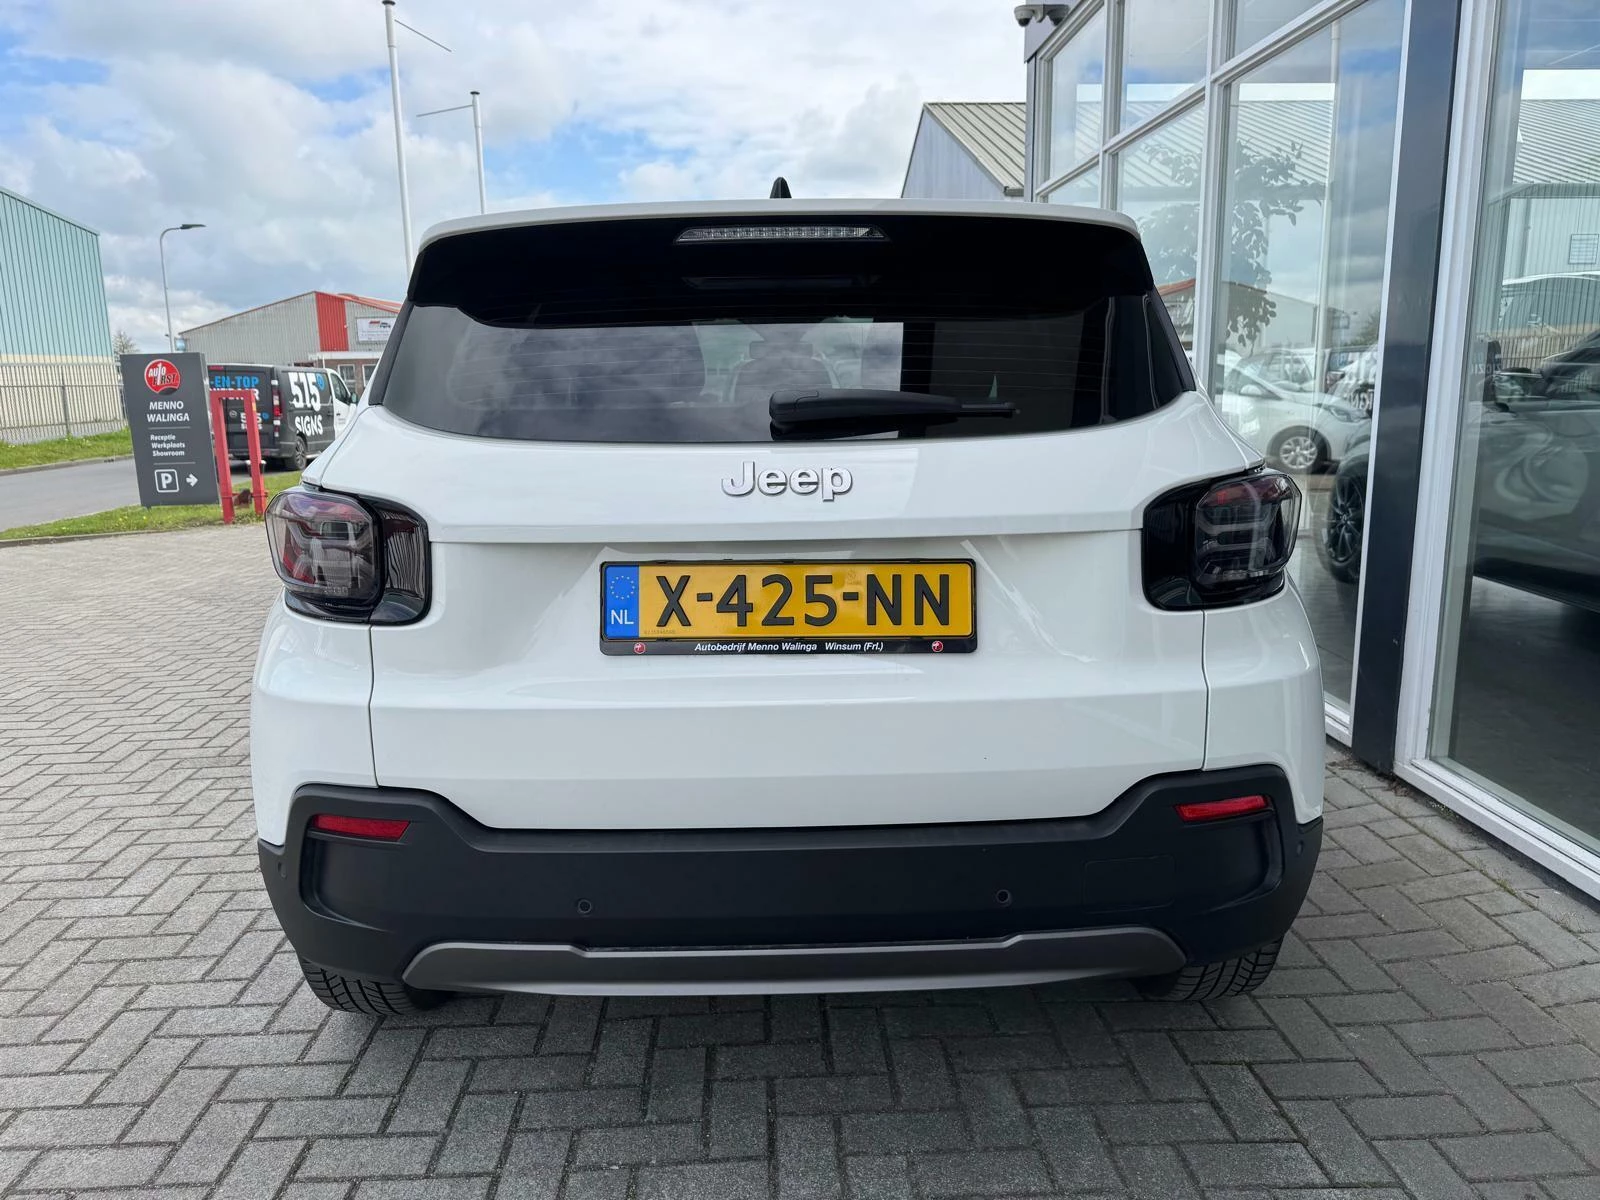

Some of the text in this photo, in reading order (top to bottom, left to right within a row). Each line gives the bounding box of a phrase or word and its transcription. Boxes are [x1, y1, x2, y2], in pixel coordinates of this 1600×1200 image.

[210, 375, 260, 388] -EN-TOP
[149, 400, 184, 411] MENNO
[146, 412, 190, 423] WALINGA
[294, 414, 324, 437] SIGNS
[150, 434, 176, 442] Receptie
[151, 441, 186, 450] Werkplaats
[721, 461, 853, 502] Jeep
[656, 574, 950, 627] X-425-NN
[610, 609, 635, 625] NL
[694, 642, 747, 653] Autobedrijf
[747, 642, 779, 651] Menno
[781, 642, 818, 653] Walinga
[825, 642, 862, 651] Winsum
